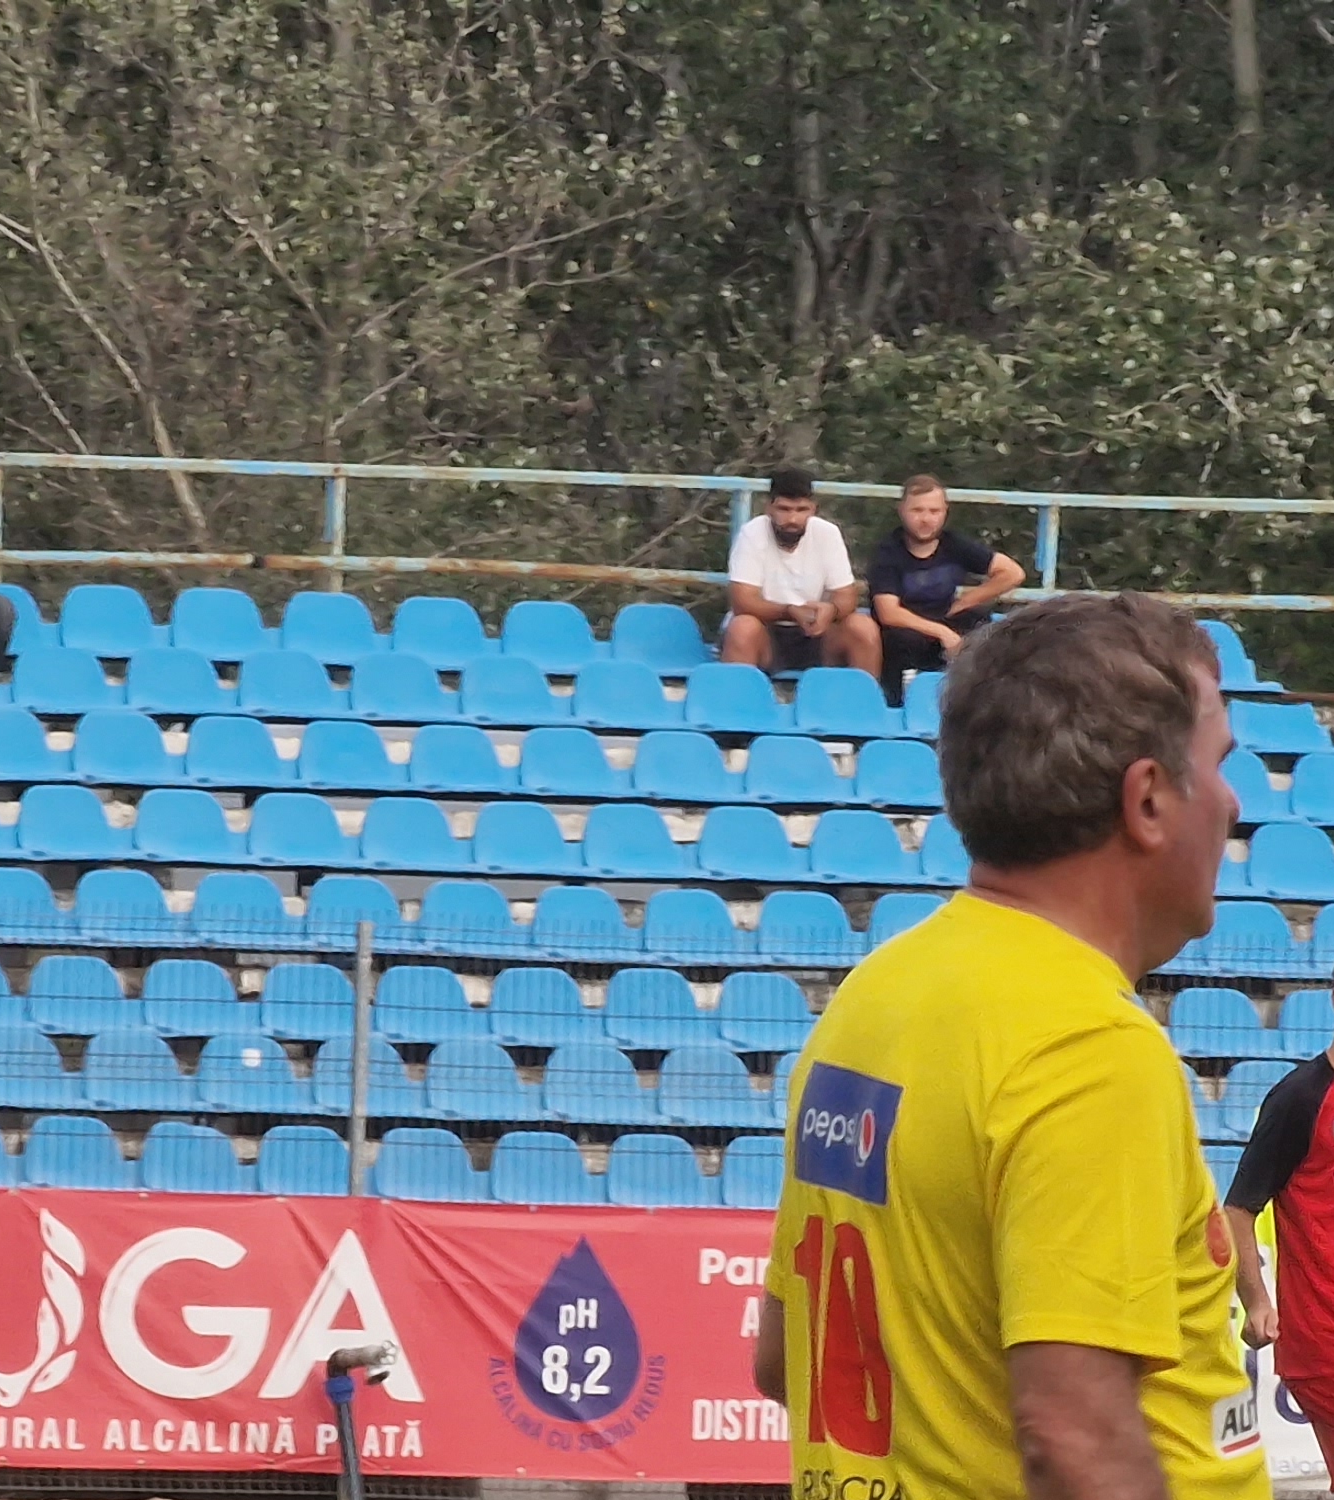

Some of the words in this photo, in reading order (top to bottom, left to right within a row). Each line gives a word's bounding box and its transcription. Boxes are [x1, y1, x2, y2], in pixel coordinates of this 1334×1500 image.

[559, 1298, 598, 1336] pH
[541, 1345, 612, 1403] 8,2
[103, 1416, 297, 1455] ALCALINĂ
[315, 1419, 425, 1459] PATĂ
